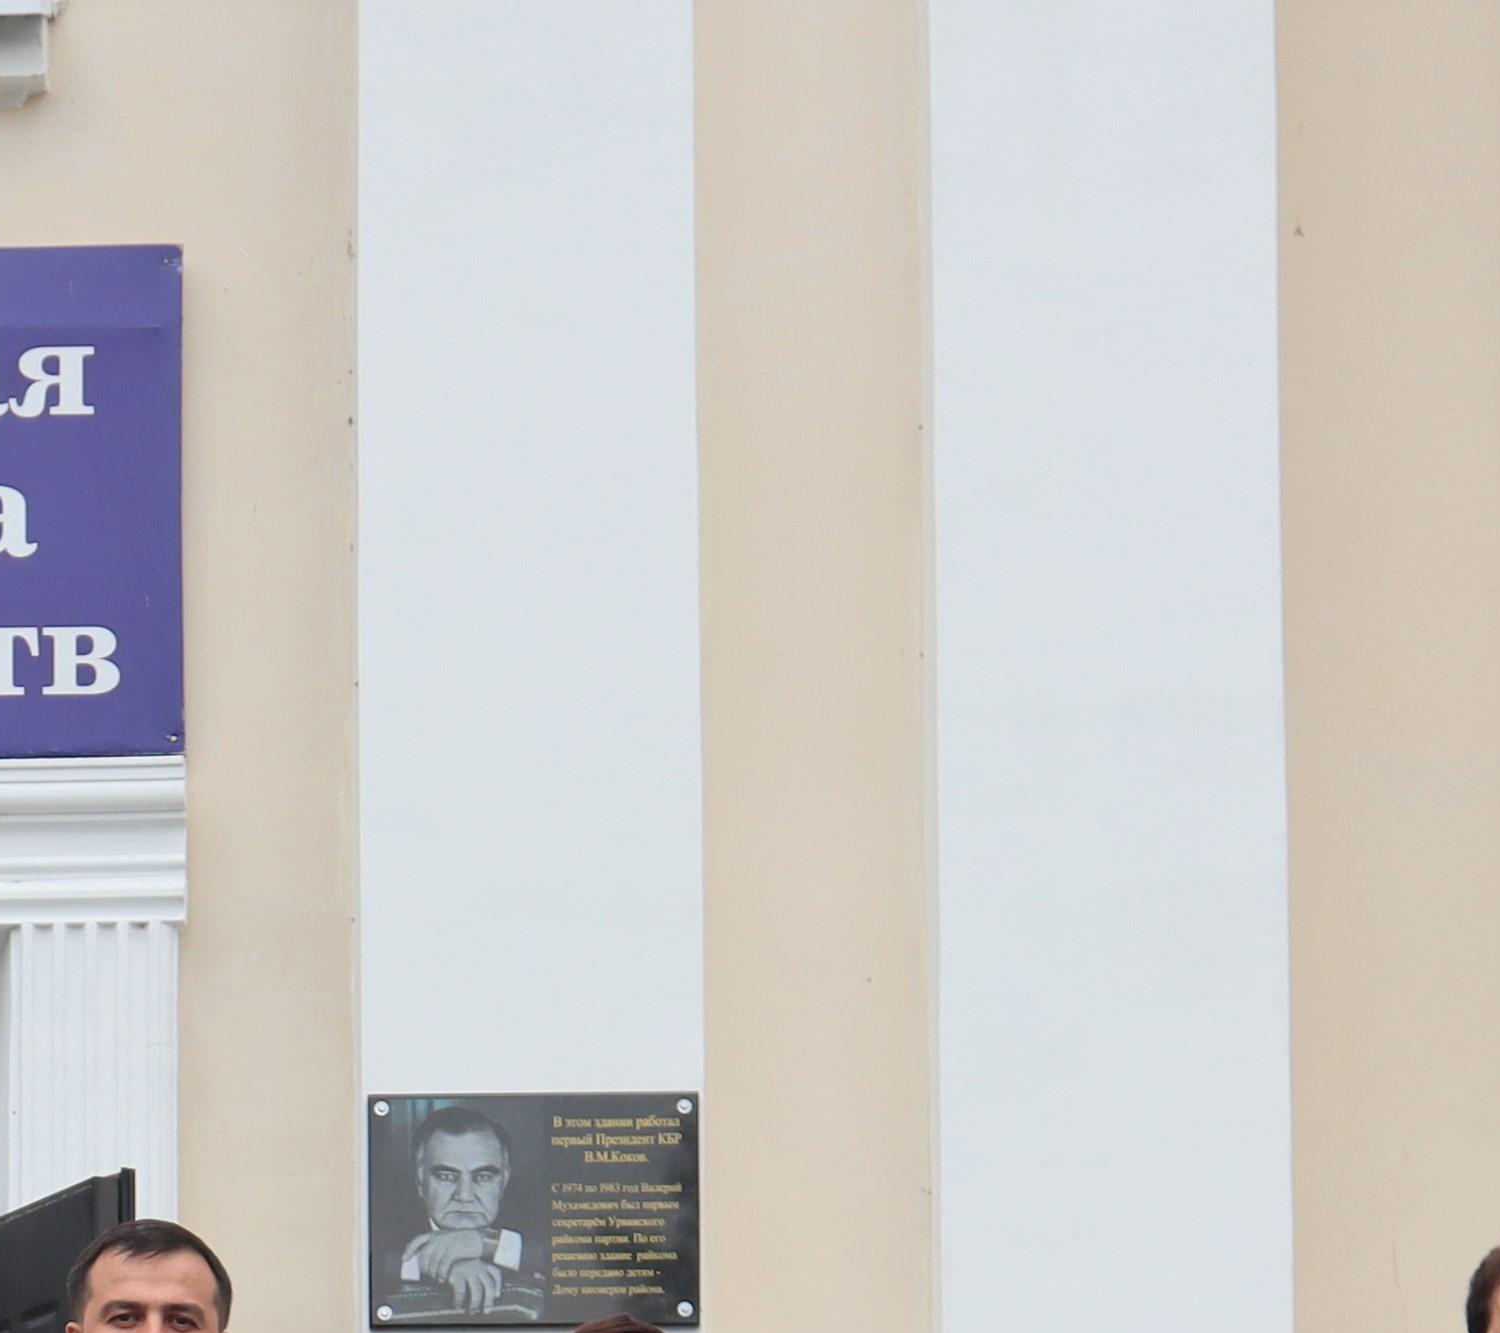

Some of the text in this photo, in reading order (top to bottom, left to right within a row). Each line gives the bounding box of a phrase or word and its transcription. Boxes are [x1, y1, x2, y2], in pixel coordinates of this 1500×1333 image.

[553, 1115, 563, 1128] В
[635, 1115, 680, 1129] работал
[551, 1132, 682, 1148] первый Президент КБР
[633, 1232, 648, 1243] По
[649, 1235, 666, 1244] его
